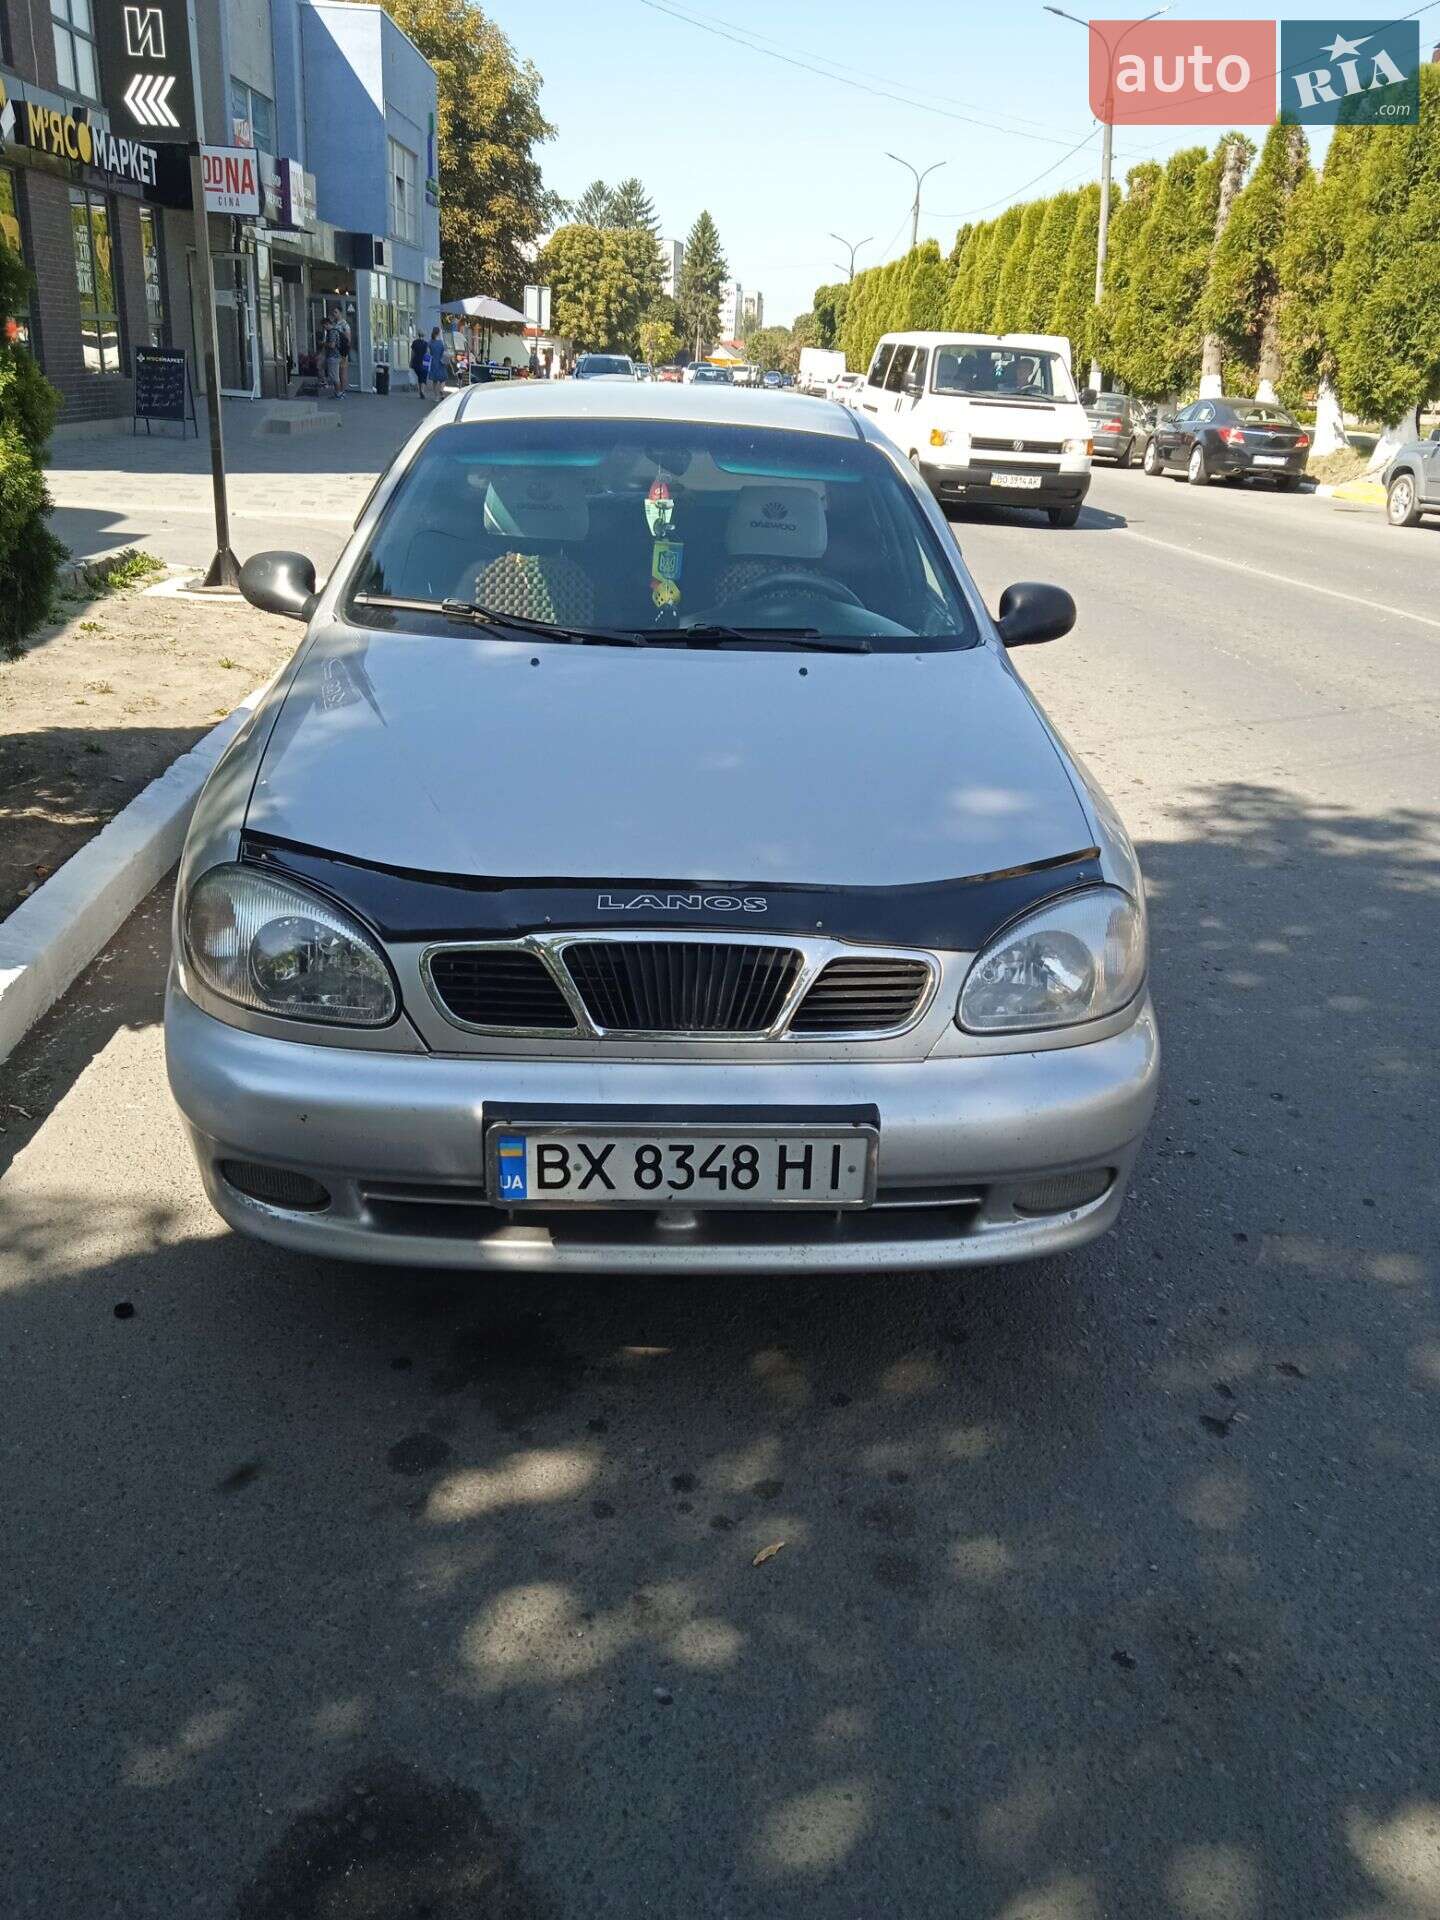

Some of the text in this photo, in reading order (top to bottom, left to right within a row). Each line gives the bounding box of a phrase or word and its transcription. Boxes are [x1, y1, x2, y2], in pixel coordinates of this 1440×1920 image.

[597, 894, 768, 912] LANOS
[536, 1143, 841, 1191] BX 8348 HI
[500, 1174, 524, 1190] UA
